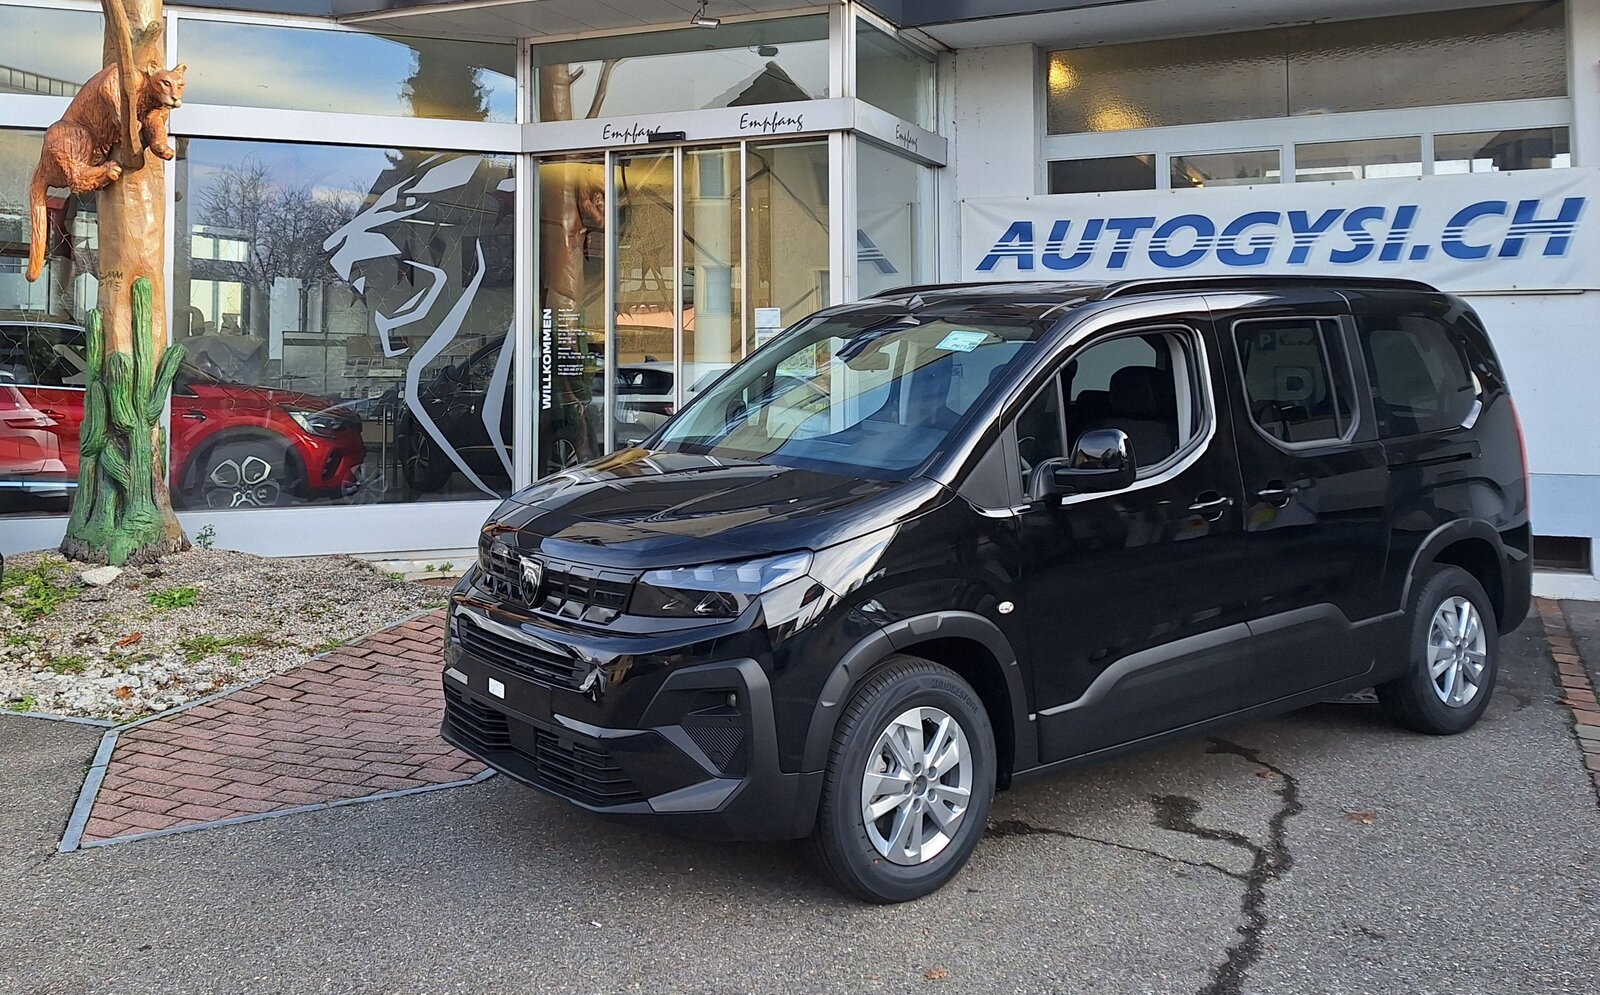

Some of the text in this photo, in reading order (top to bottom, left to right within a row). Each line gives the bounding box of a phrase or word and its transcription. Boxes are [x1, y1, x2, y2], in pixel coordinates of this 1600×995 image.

[739, 111, 804, 133] Empfang
[895, 124, 918, 152] Empfang
[975, 196, 1587, 273] AUTOGYSI.CH
[542, 308, 552, 410] WILLKOMMEN
